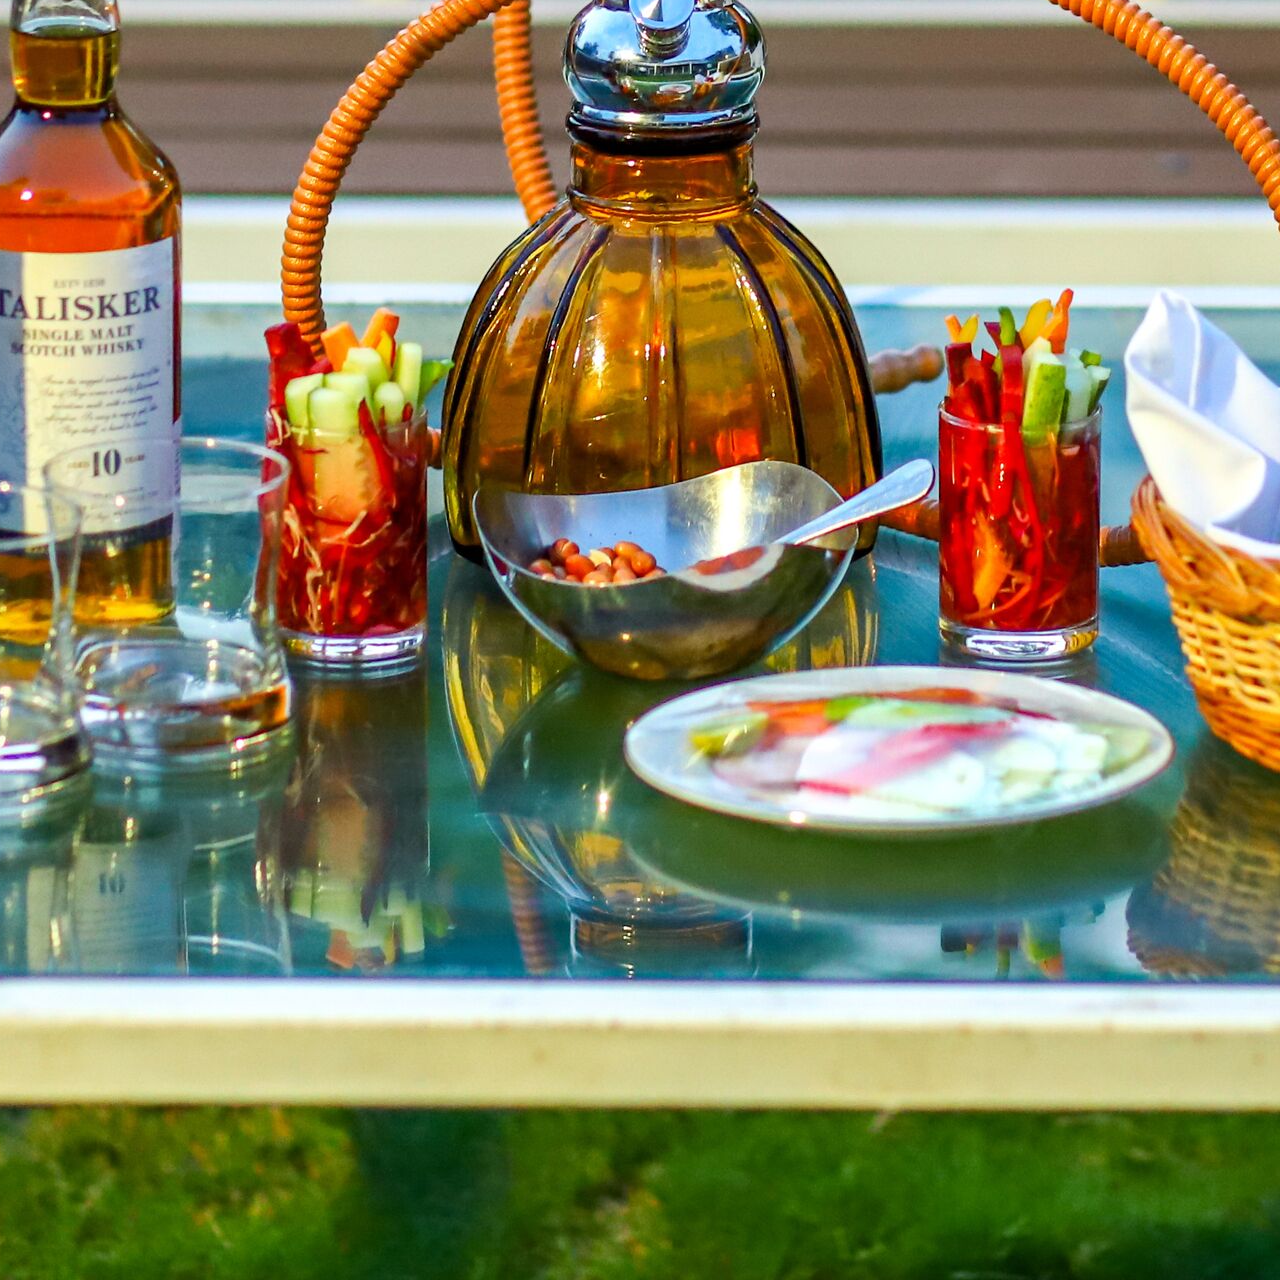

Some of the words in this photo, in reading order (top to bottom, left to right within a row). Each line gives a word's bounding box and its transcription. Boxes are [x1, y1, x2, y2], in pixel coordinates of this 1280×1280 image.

[23, 328, 85, 341] SINGLE
[90, 324, 134, 341] MALT
[10, 342, 76, 357] SCOTCH
[81, 337, 145, 356] WHISKY
[93, 449, 121, 477] 10
